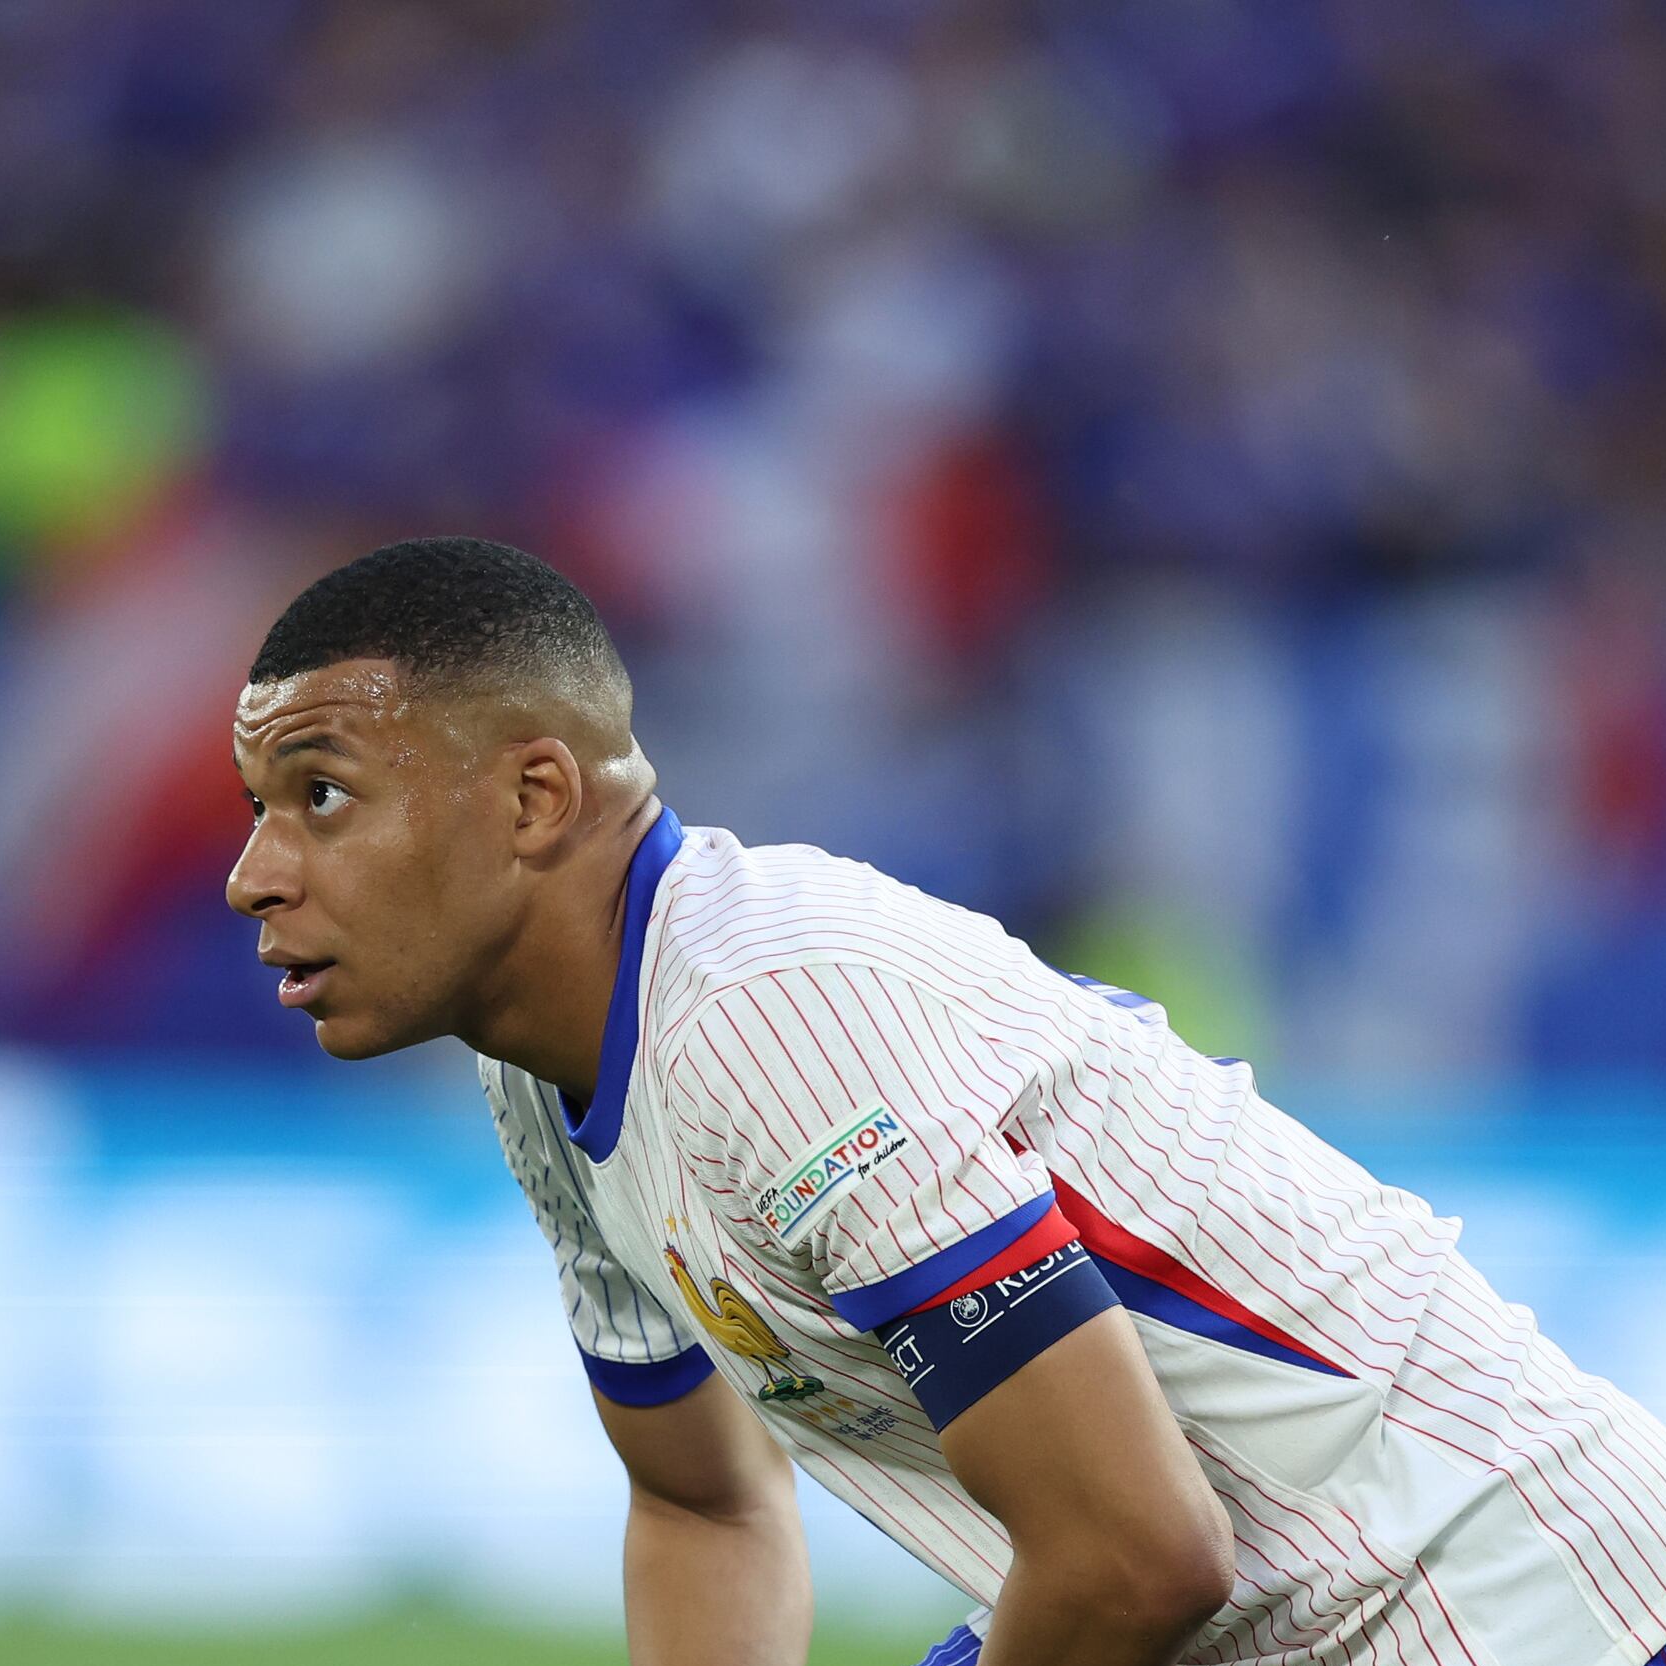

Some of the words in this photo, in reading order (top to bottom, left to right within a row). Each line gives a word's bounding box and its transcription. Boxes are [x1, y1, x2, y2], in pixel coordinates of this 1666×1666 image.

[858, 1162, 871, 1180] for
[874, 1137, 908, 1165] children
[755, 1186, 780, 1215] UEFA
